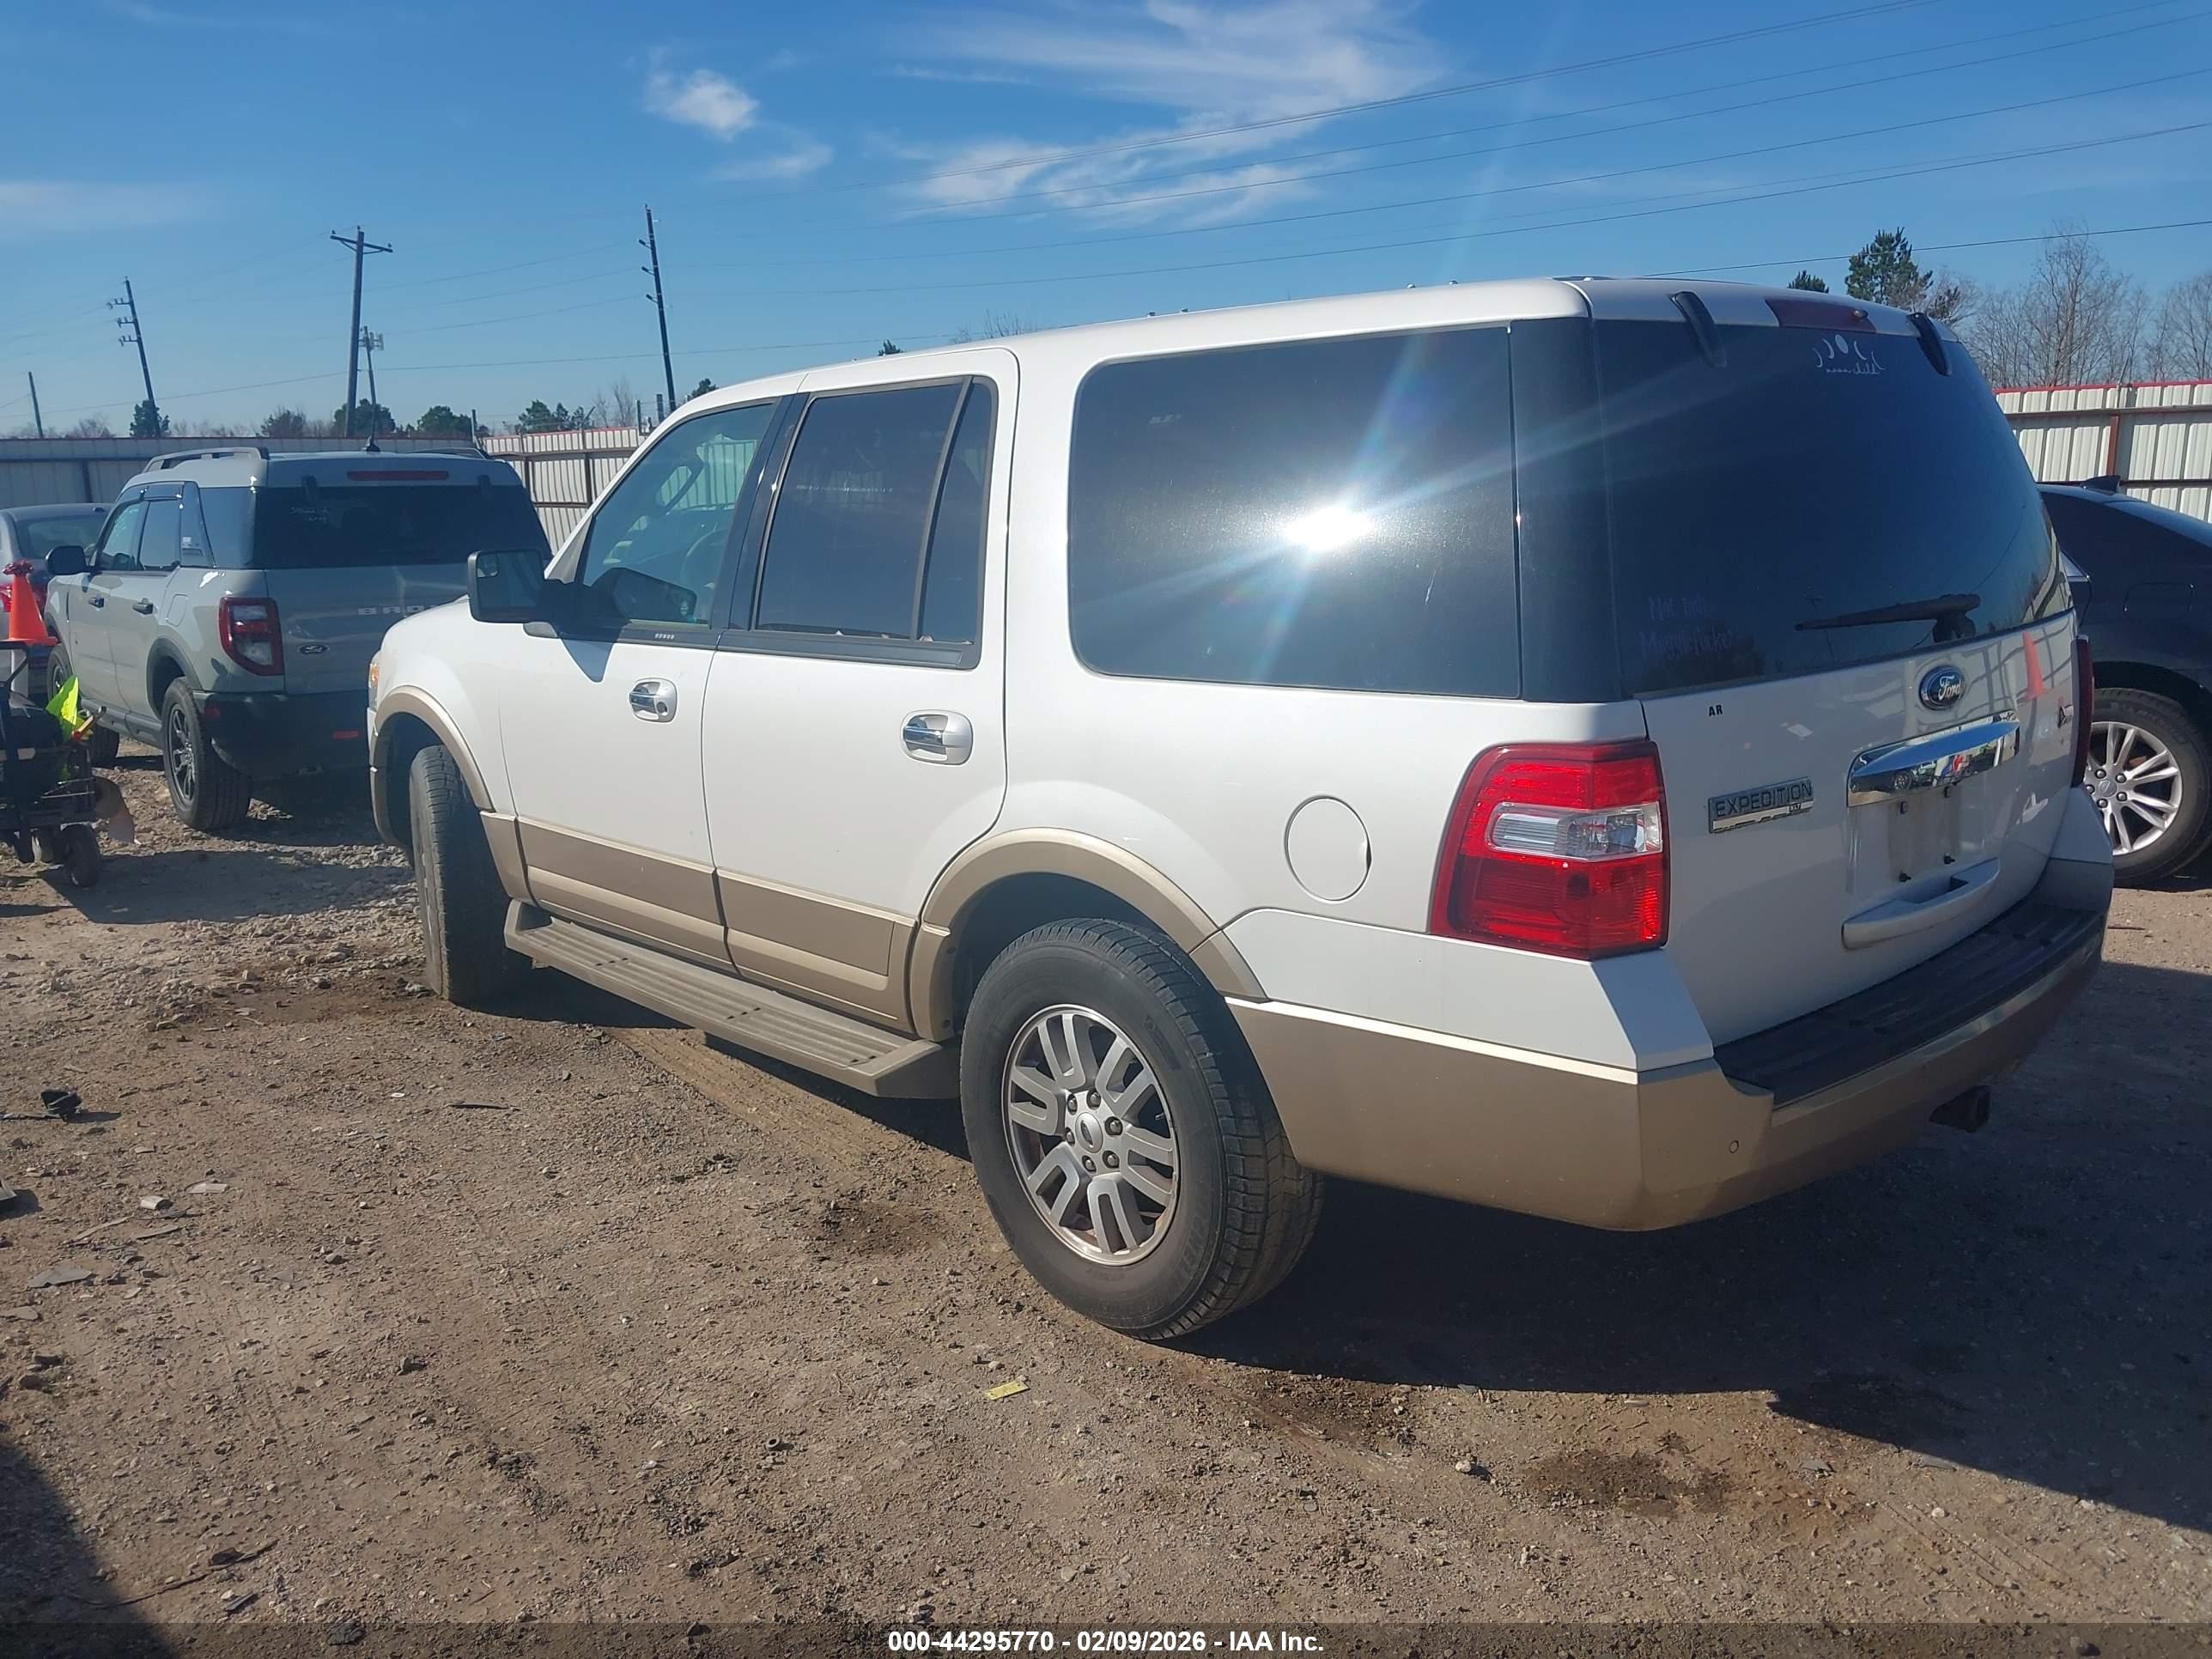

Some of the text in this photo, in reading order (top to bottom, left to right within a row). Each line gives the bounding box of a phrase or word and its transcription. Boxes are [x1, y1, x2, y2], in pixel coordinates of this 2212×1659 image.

[1938, 674, 1965, 701] Ford
[1709, 704, 1723, 717] AR
[1715, 780, 1813, 817] EXPEDITION
